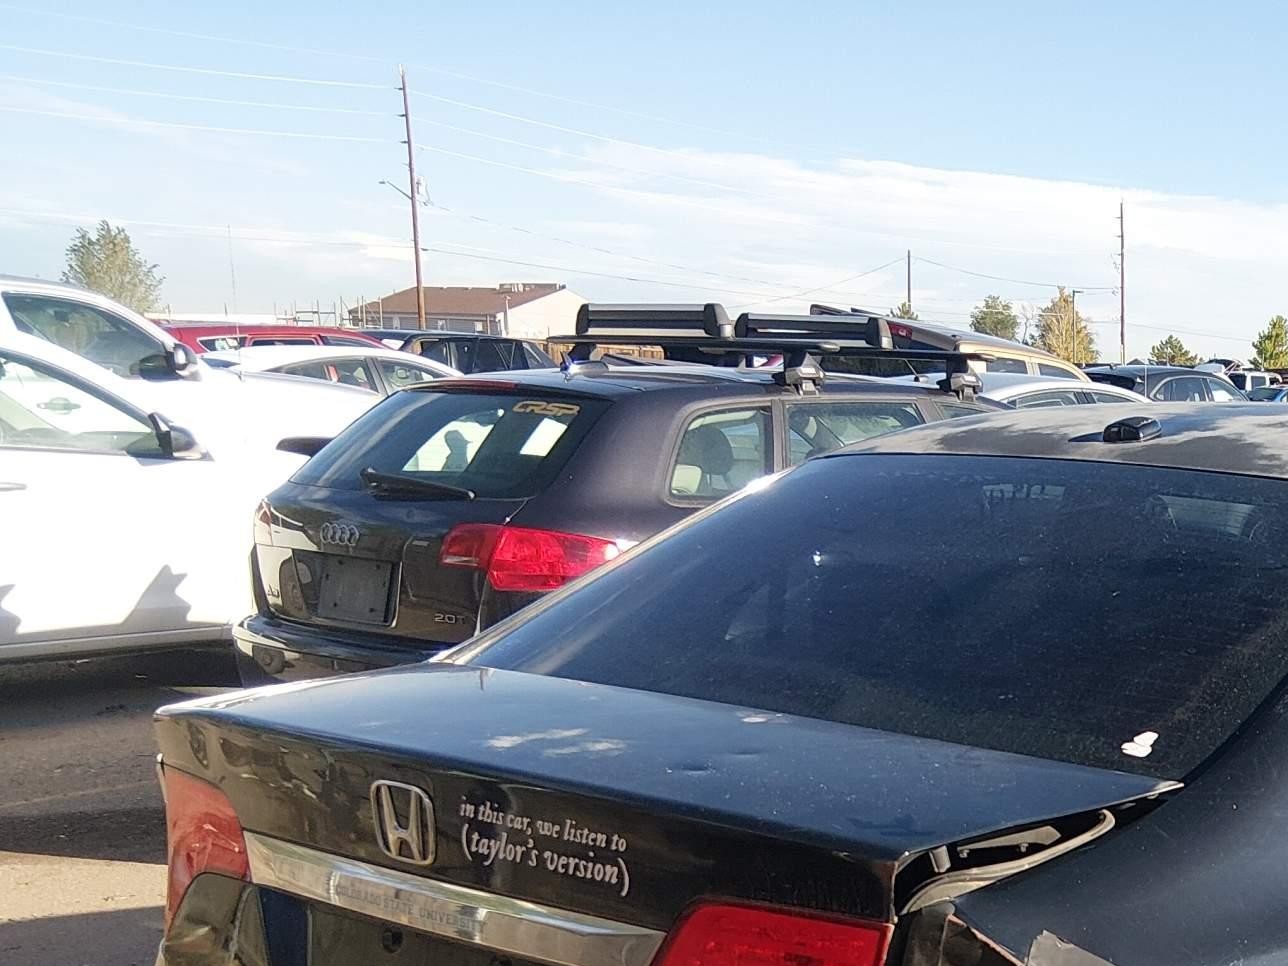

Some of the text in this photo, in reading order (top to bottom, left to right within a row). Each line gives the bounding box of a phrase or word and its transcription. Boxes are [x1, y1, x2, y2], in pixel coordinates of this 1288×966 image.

[459, 795, 627, 852] in this car, we listen to
[461, 823, 630, 897] (taylor's version)
[383, 898, 415, 916] STATE
[418, 908, 488, 934] UNIVERSITY
